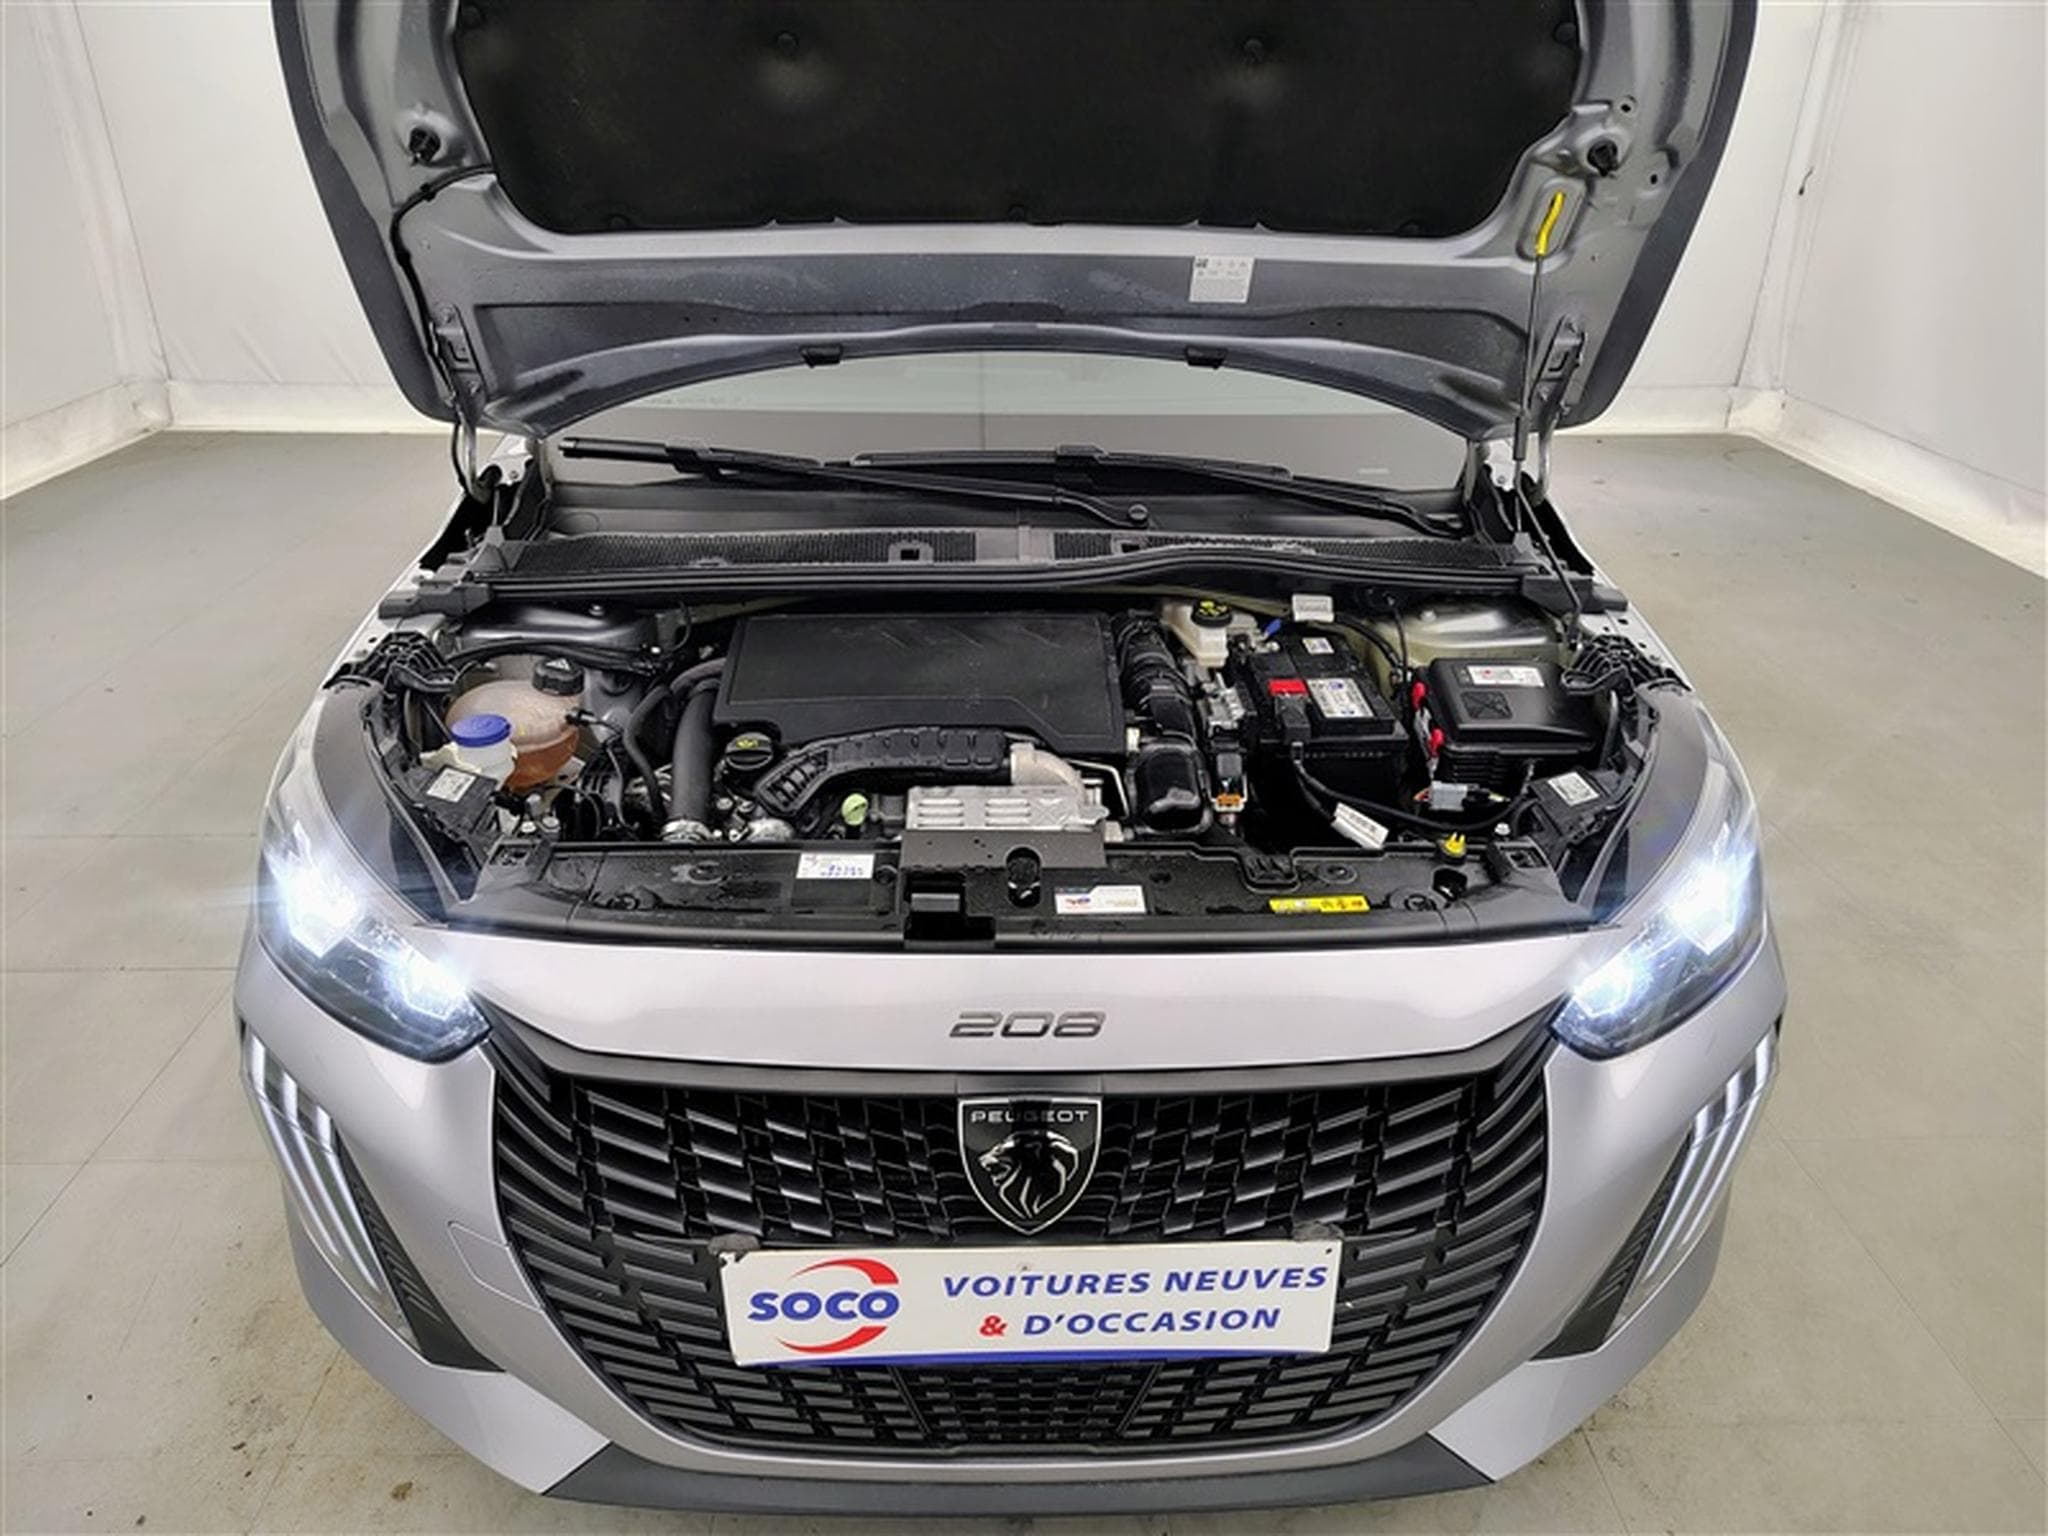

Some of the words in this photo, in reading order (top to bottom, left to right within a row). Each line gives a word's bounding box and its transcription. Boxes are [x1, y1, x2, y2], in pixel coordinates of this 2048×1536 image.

[949, 1010, 1106, 1038] 208
[970, 1109, 1089, 1123] PEUGEOT
[943, 1272, 1151, 1297] VOITURES
[1163, 1266, 1328, 1293] NEUVES
[747, 1290, 900, 1322] SOCO
[979, 1314, 1007, 1338] &
